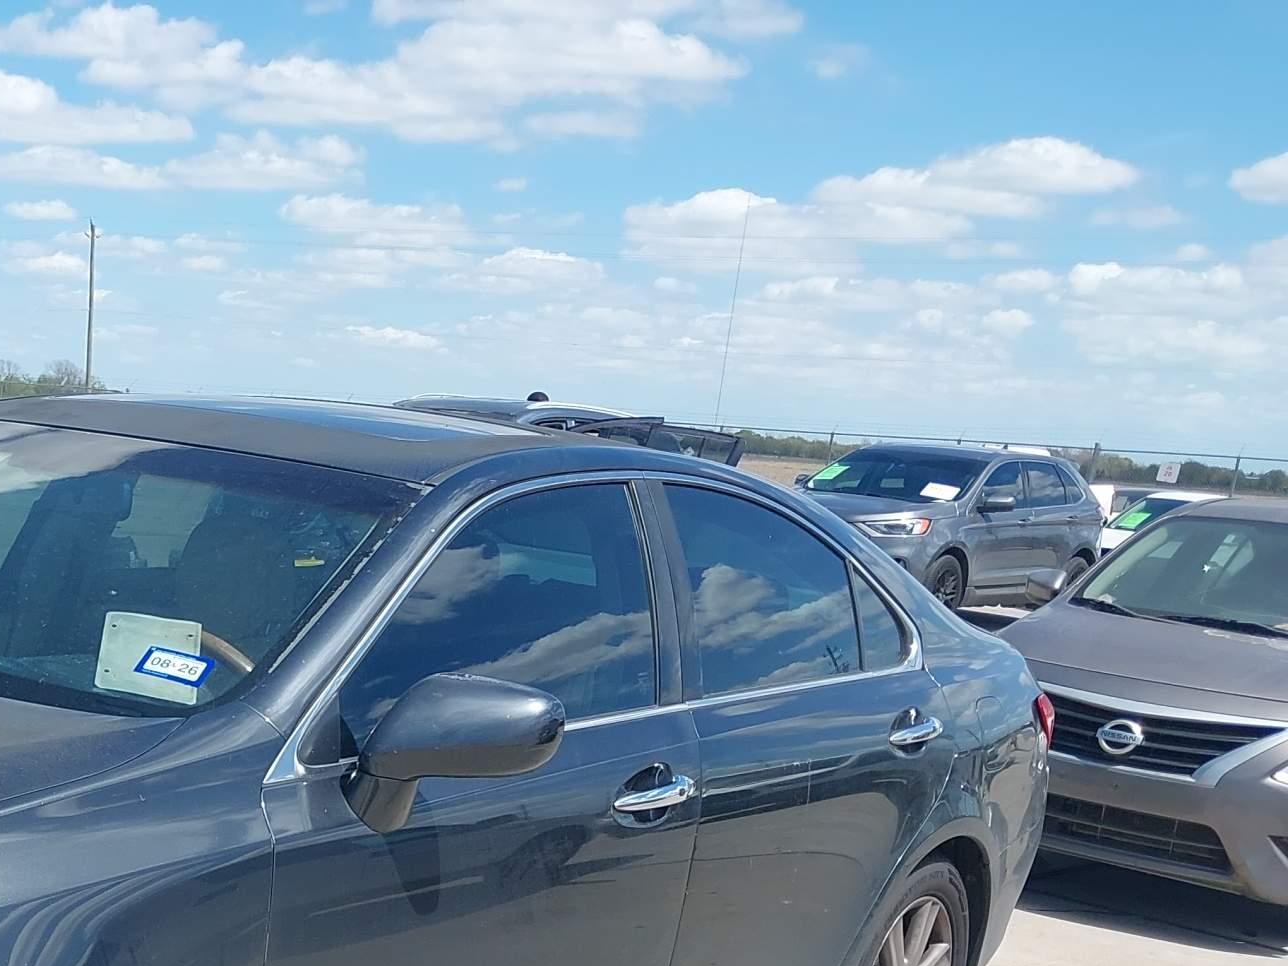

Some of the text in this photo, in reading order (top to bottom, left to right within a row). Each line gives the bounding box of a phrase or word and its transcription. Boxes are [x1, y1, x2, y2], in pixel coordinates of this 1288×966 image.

[150, 656, 200, 676] 08 26
[1102, 730, 1138, 742] NISSAN
